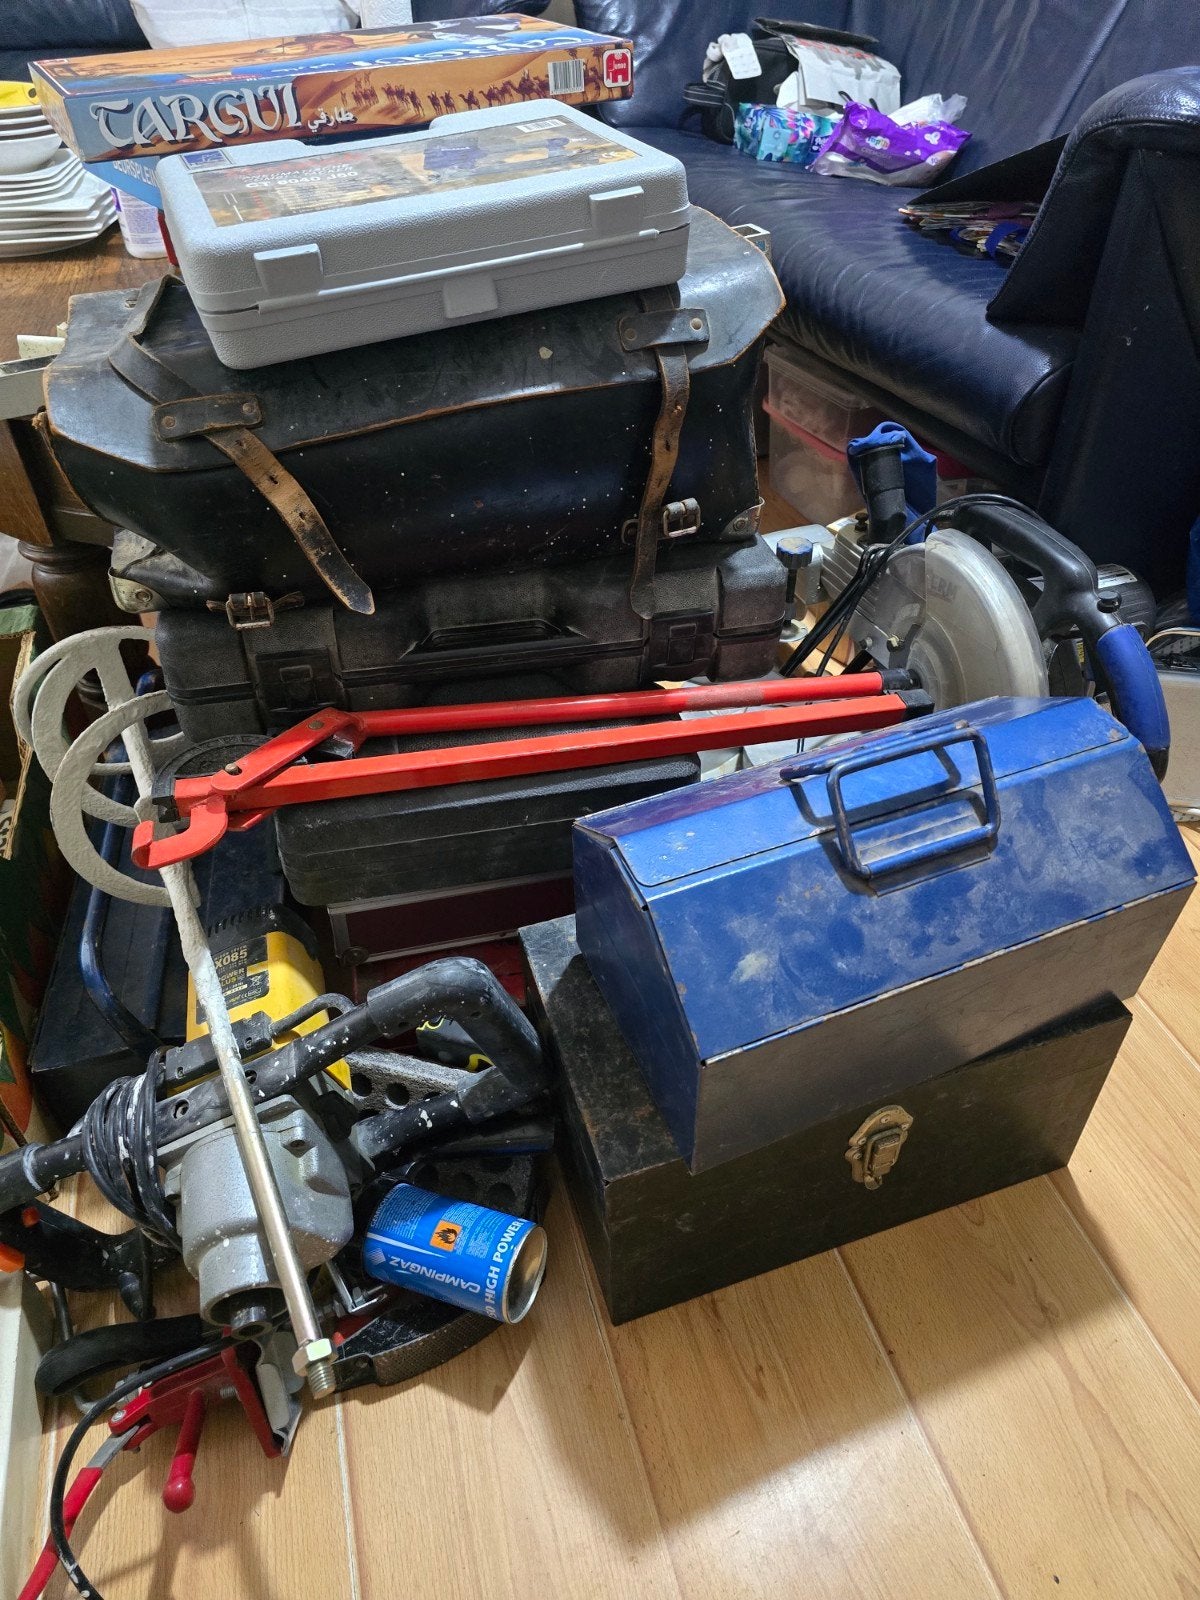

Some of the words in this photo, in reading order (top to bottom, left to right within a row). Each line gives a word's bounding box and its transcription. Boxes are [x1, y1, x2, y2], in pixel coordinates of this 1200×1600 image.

[90, 83, 302, 147] TARGUI
[307, 106, 355, 133] طارقي
[214, 949, 248, 969] X085
[219, 967, 245, 981] OWER
[389, 1256, 481, 1294] CAMPINGAZ
[484, 1265, 500, 1304] HIGH
[493, 1218, 524, 1263] POWER
